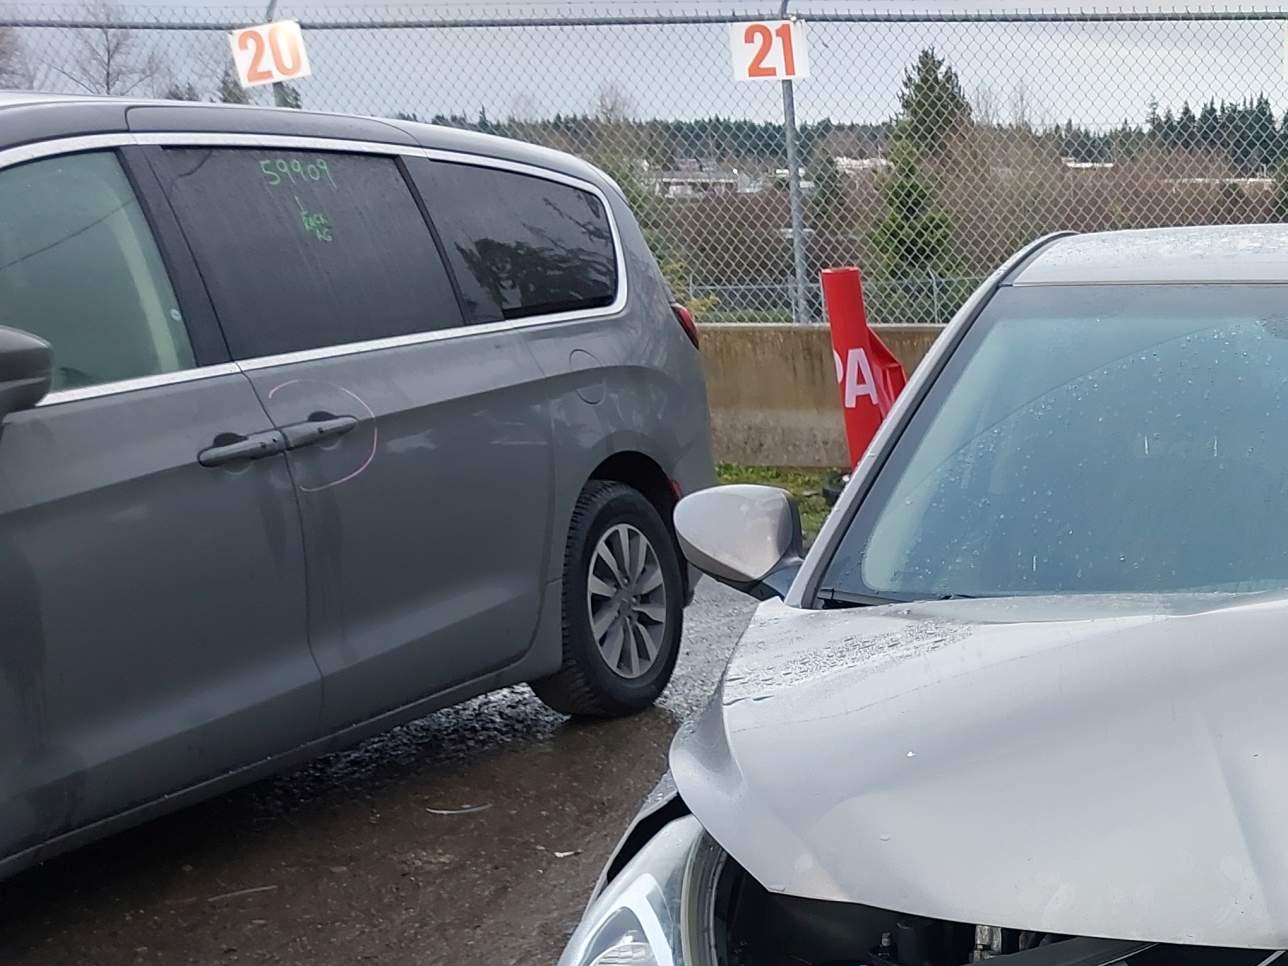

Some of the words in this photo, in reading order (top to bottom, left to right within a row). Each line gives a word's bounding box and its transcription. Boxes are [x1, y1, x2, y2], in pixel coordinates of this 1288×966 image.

[238, 29, 302, 82] 20
[743, 23, 796, 77] 21
[259, 159, 338, 190] 59909
